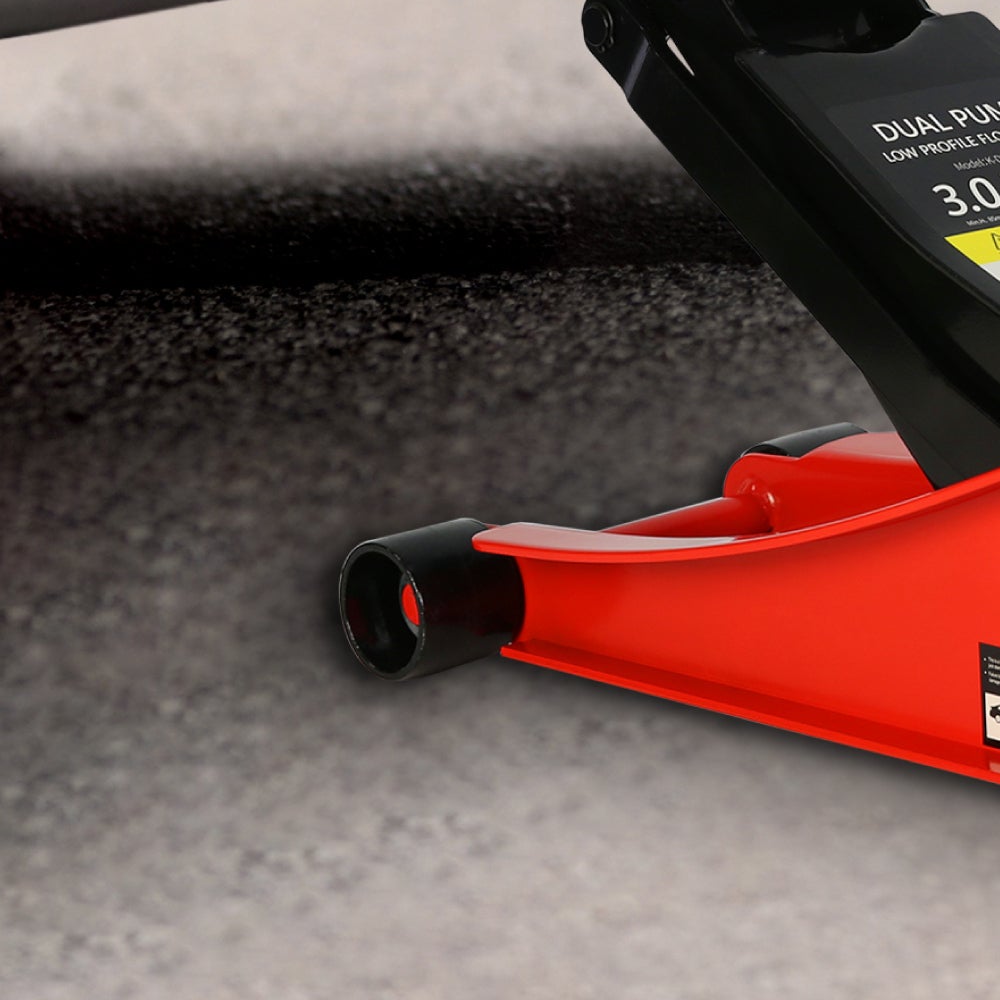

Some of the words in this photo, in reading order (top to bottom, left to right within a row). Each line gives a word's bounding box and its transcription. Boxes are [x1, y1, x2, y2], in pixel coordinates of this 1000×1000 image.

[872, 114, 953, 143] DUAL
[882, 146, 919, 164] LOW
[919, 135, 979, 156] PROFILE
